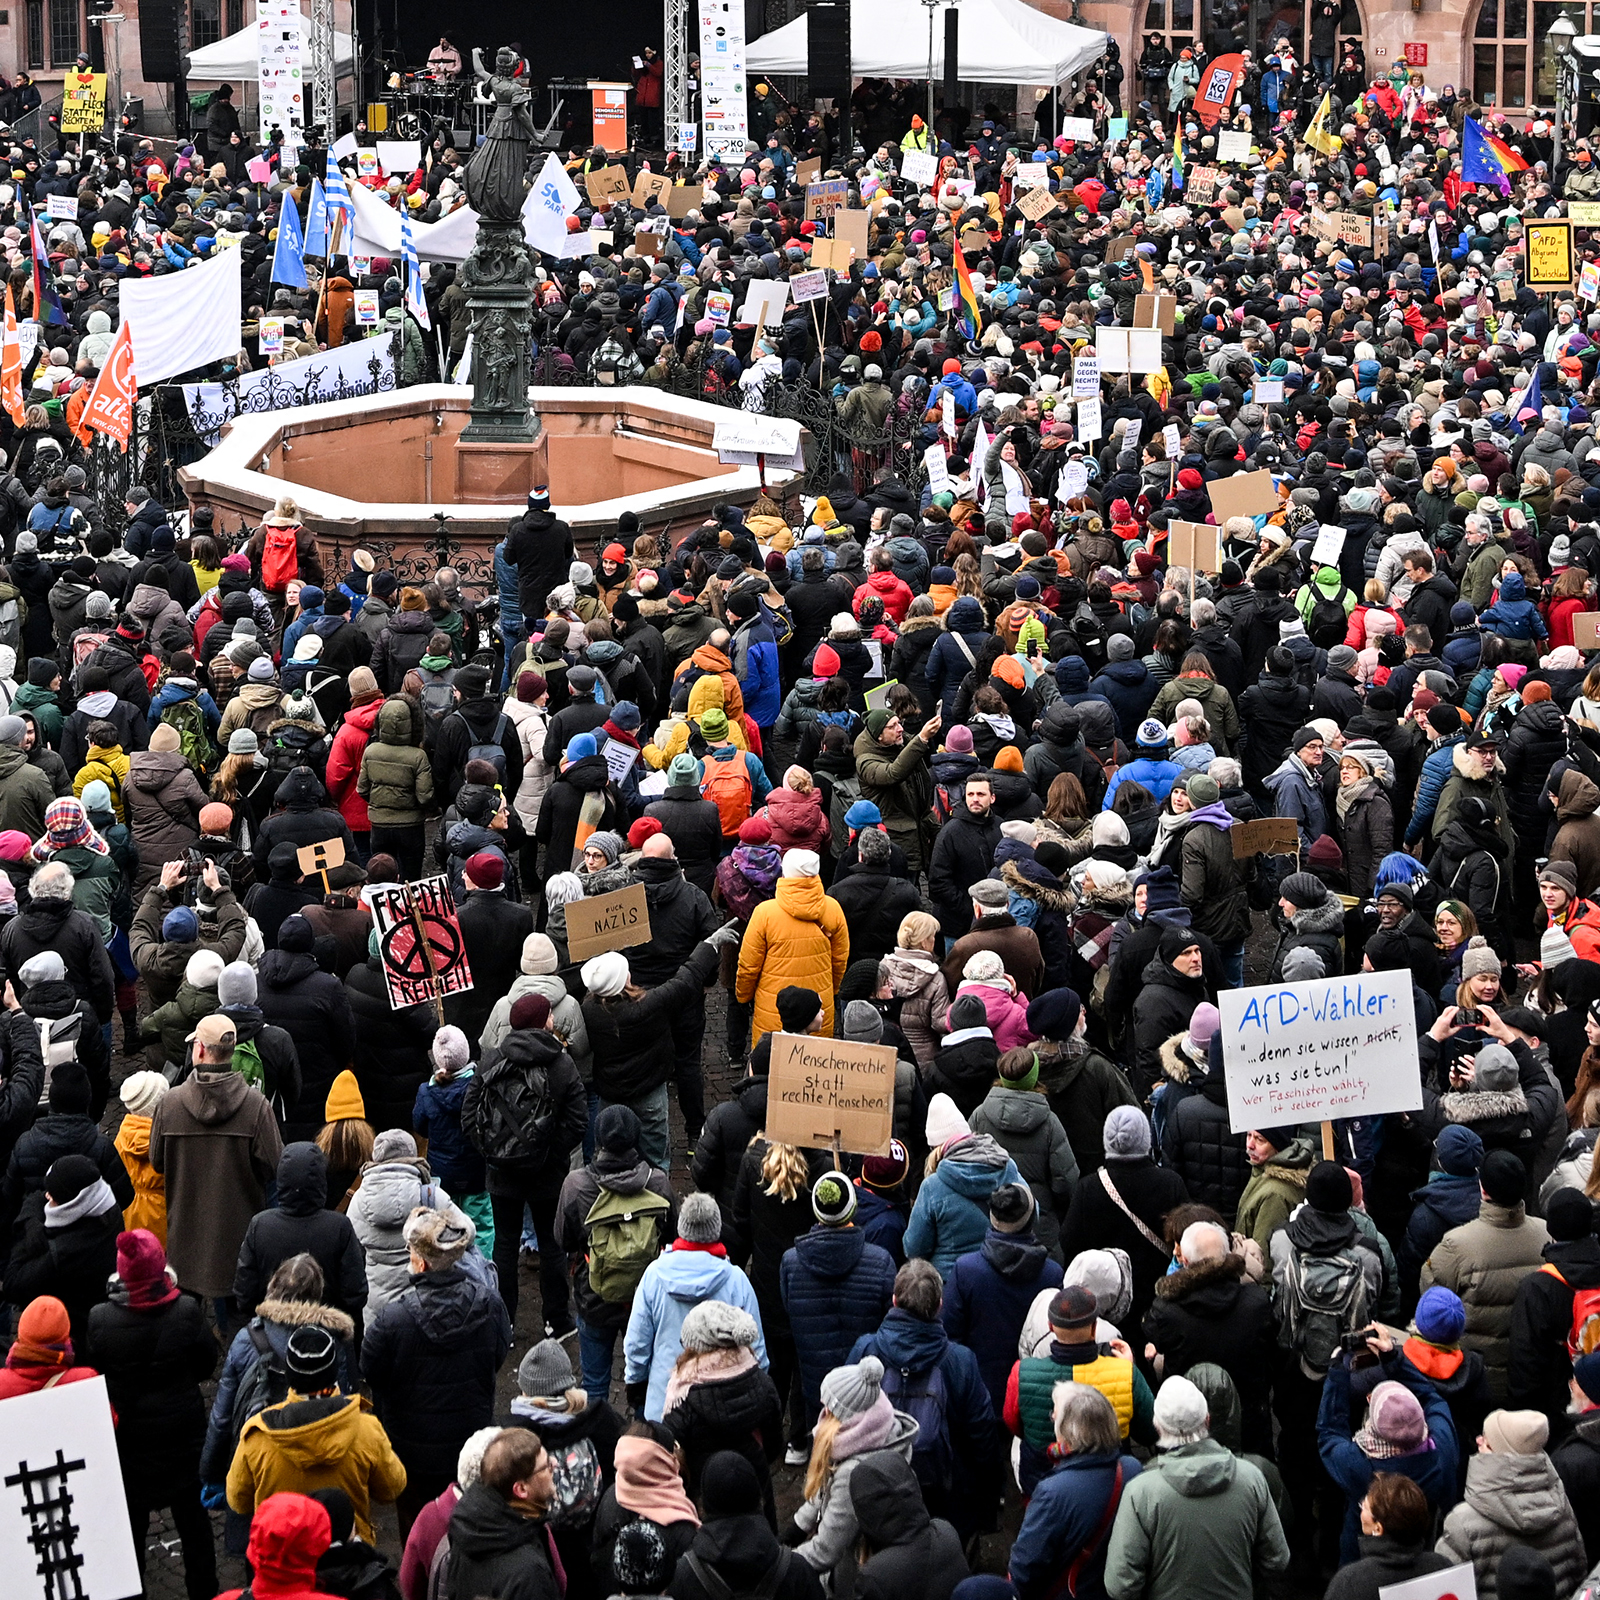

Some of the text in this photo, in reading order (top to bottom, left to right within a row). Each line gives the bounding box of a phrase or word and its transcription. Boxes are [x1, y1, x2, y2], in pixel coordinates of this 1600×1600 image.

[1209, 82, 1226, 93] KO
[731, 140, 744, 148] KO
[1340, 225, 1366, 234] SIND
[1341, 215, 1357, 227] WIR
[1337, 233, 1366, 246] MEHR!
[1076, 369, 1099, 377] GEGEN
[605, 904, 624, 914] FUCK
[594, 907, 638, 934] NAZIS
[1238, 983, 1397, 1034] AfD-Wähler:
[1296, 1040, 1316, 1056] sie
[1320, 1033, 1360, 1052] wissen
[788, 1043, 888, 1076] Menschenrechte
[805, 1074, 845, 1091] statt
[1250, 1066, 1309, 1088] was sie
[781, 1084, 884, 1109] rechte Menschen
[1241, 1094, 1265, 1107] Wer
[1268, 1082, 1328, 1103] Faschisten
[1269, 1103, 1285, 1115] ist
[1291, 1098, 1322, 1111] selber
